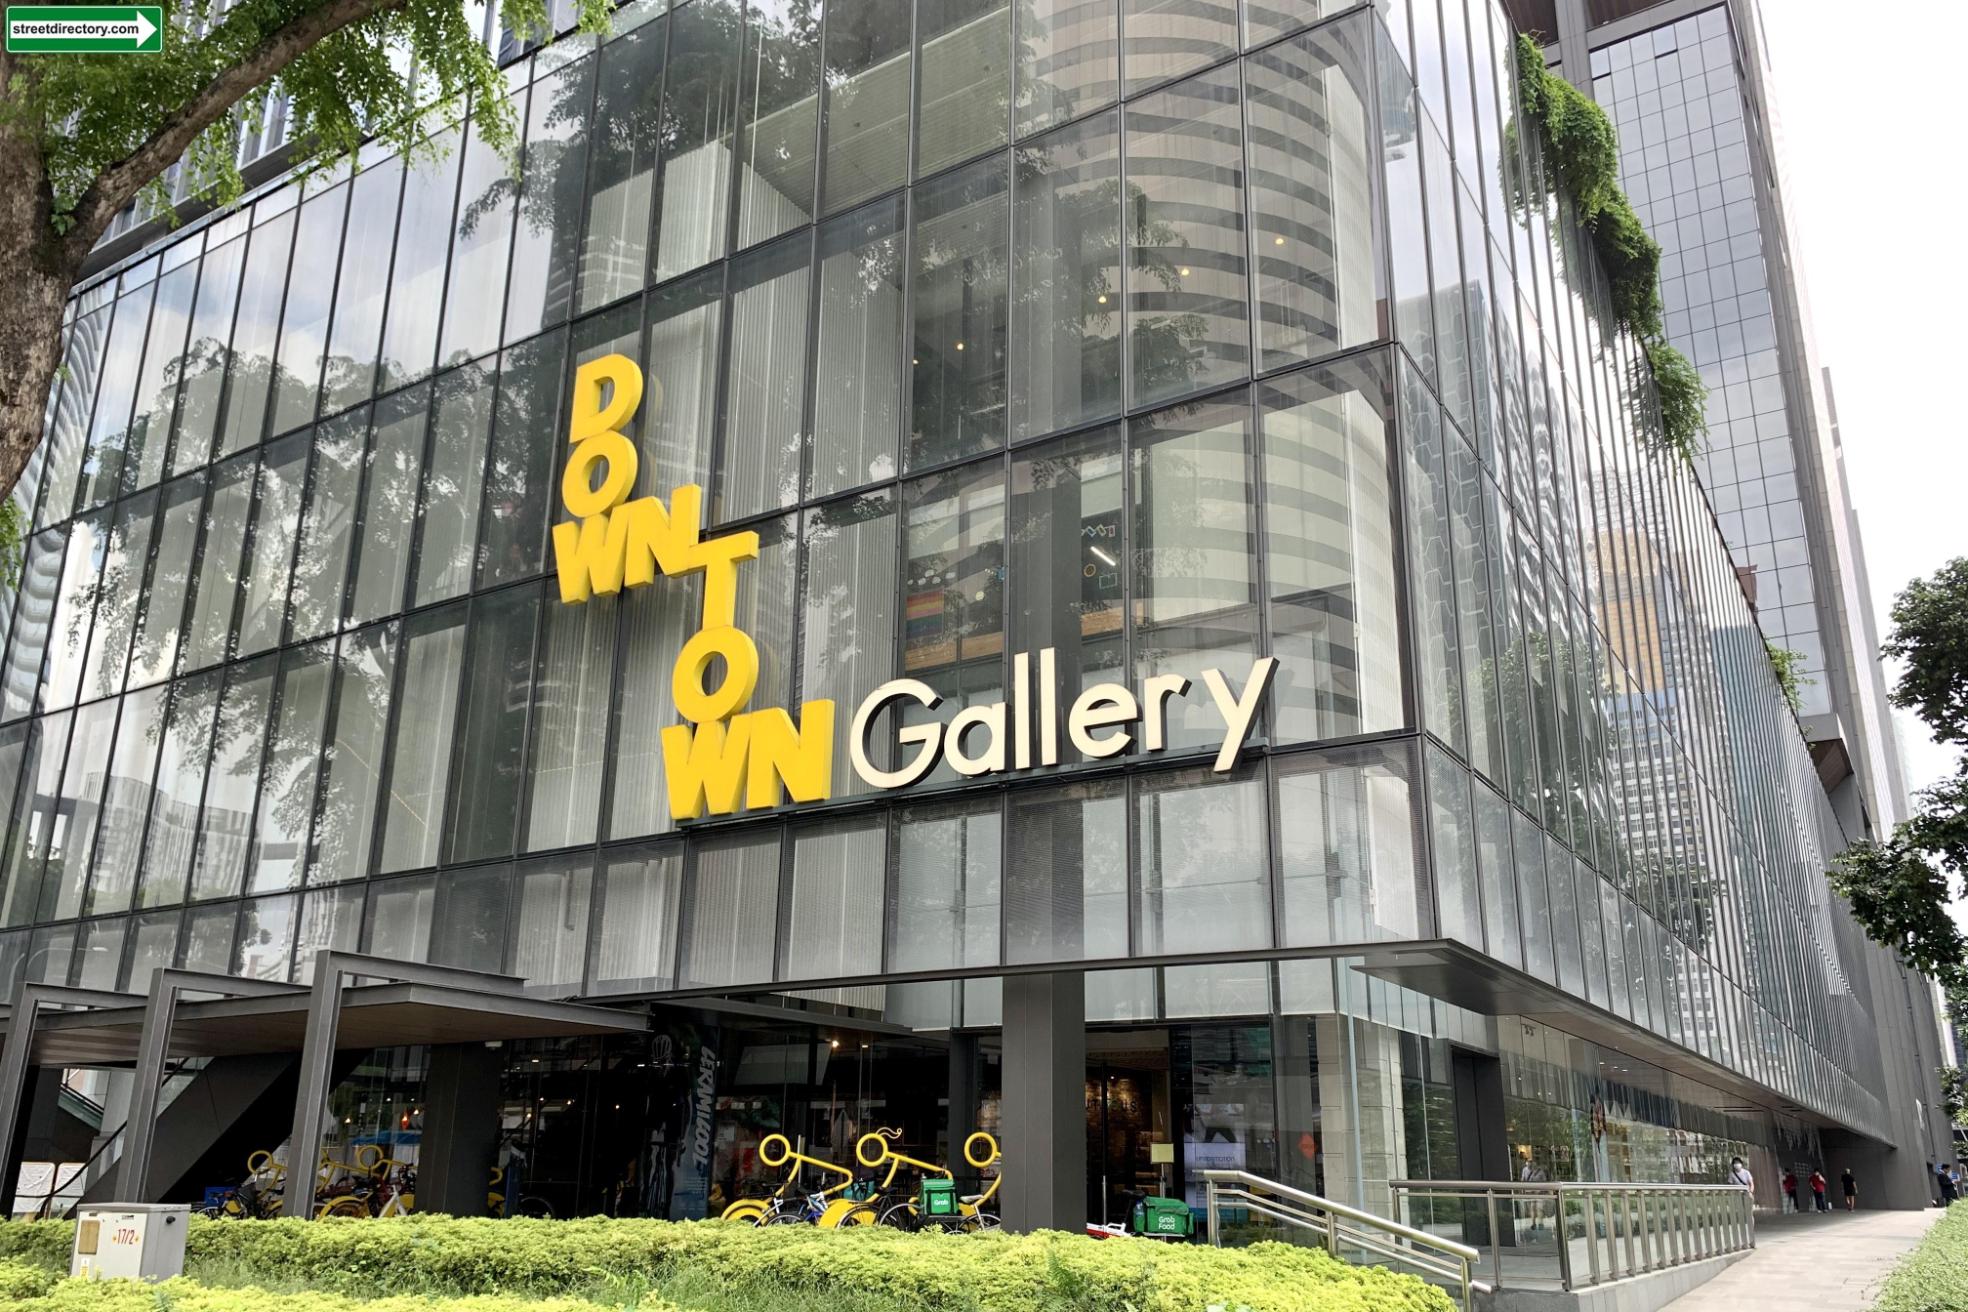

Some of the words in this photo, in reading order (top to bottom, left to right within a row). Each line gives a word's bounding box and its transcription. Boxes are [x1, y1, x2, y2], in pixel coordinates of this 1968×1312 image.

[850, 647, 1279, 788] Gallery
[1158, 1215, 1175, 1223] Grab
[1158, 1222, 1175, 1230] Food
